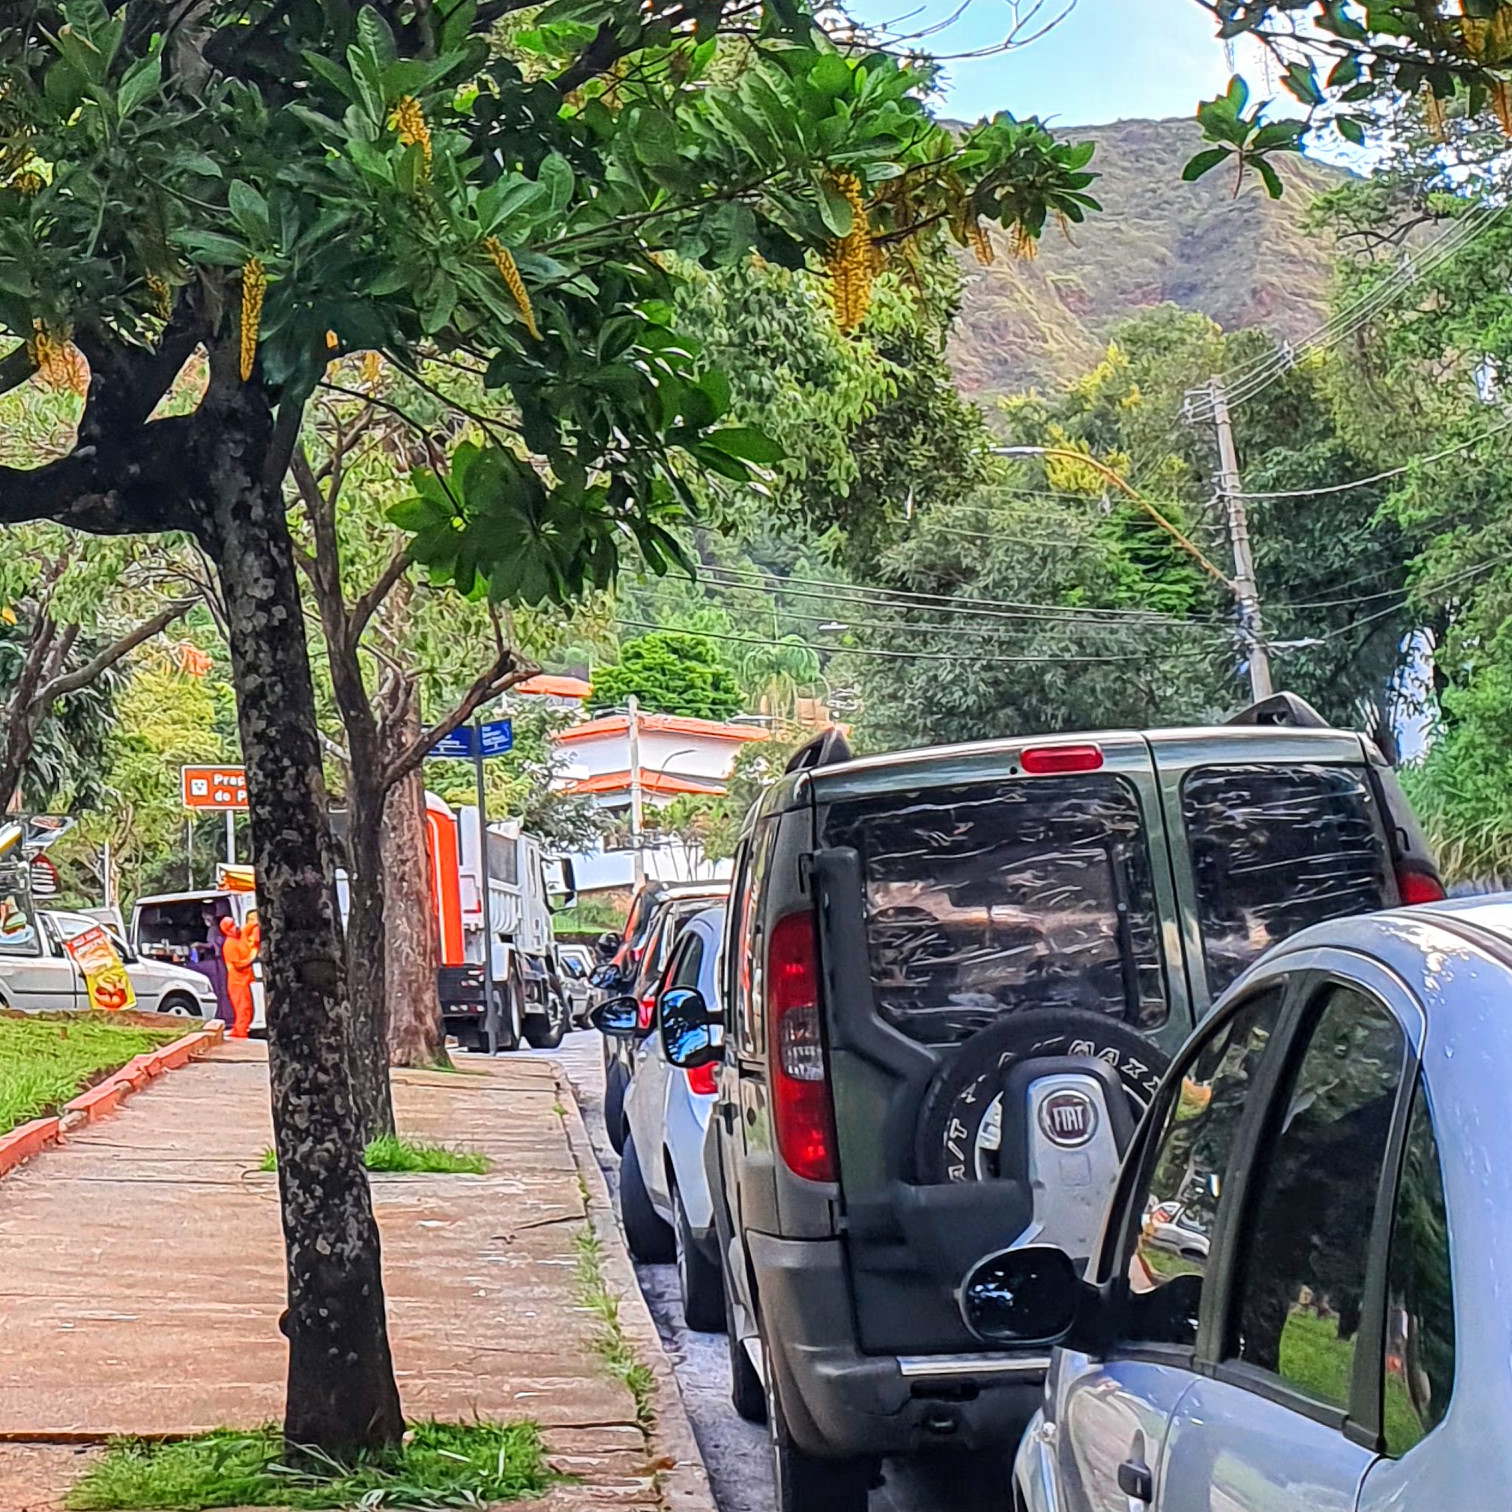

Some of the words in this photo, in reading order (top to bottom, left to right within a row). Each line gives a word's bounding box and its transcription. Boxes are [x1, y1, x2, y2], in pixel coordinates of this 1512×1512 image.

[214, 773, 245, 787] Praç
[237, 789, 248, 802] P
[1052, 1105, 1084, 1131] FIAT
